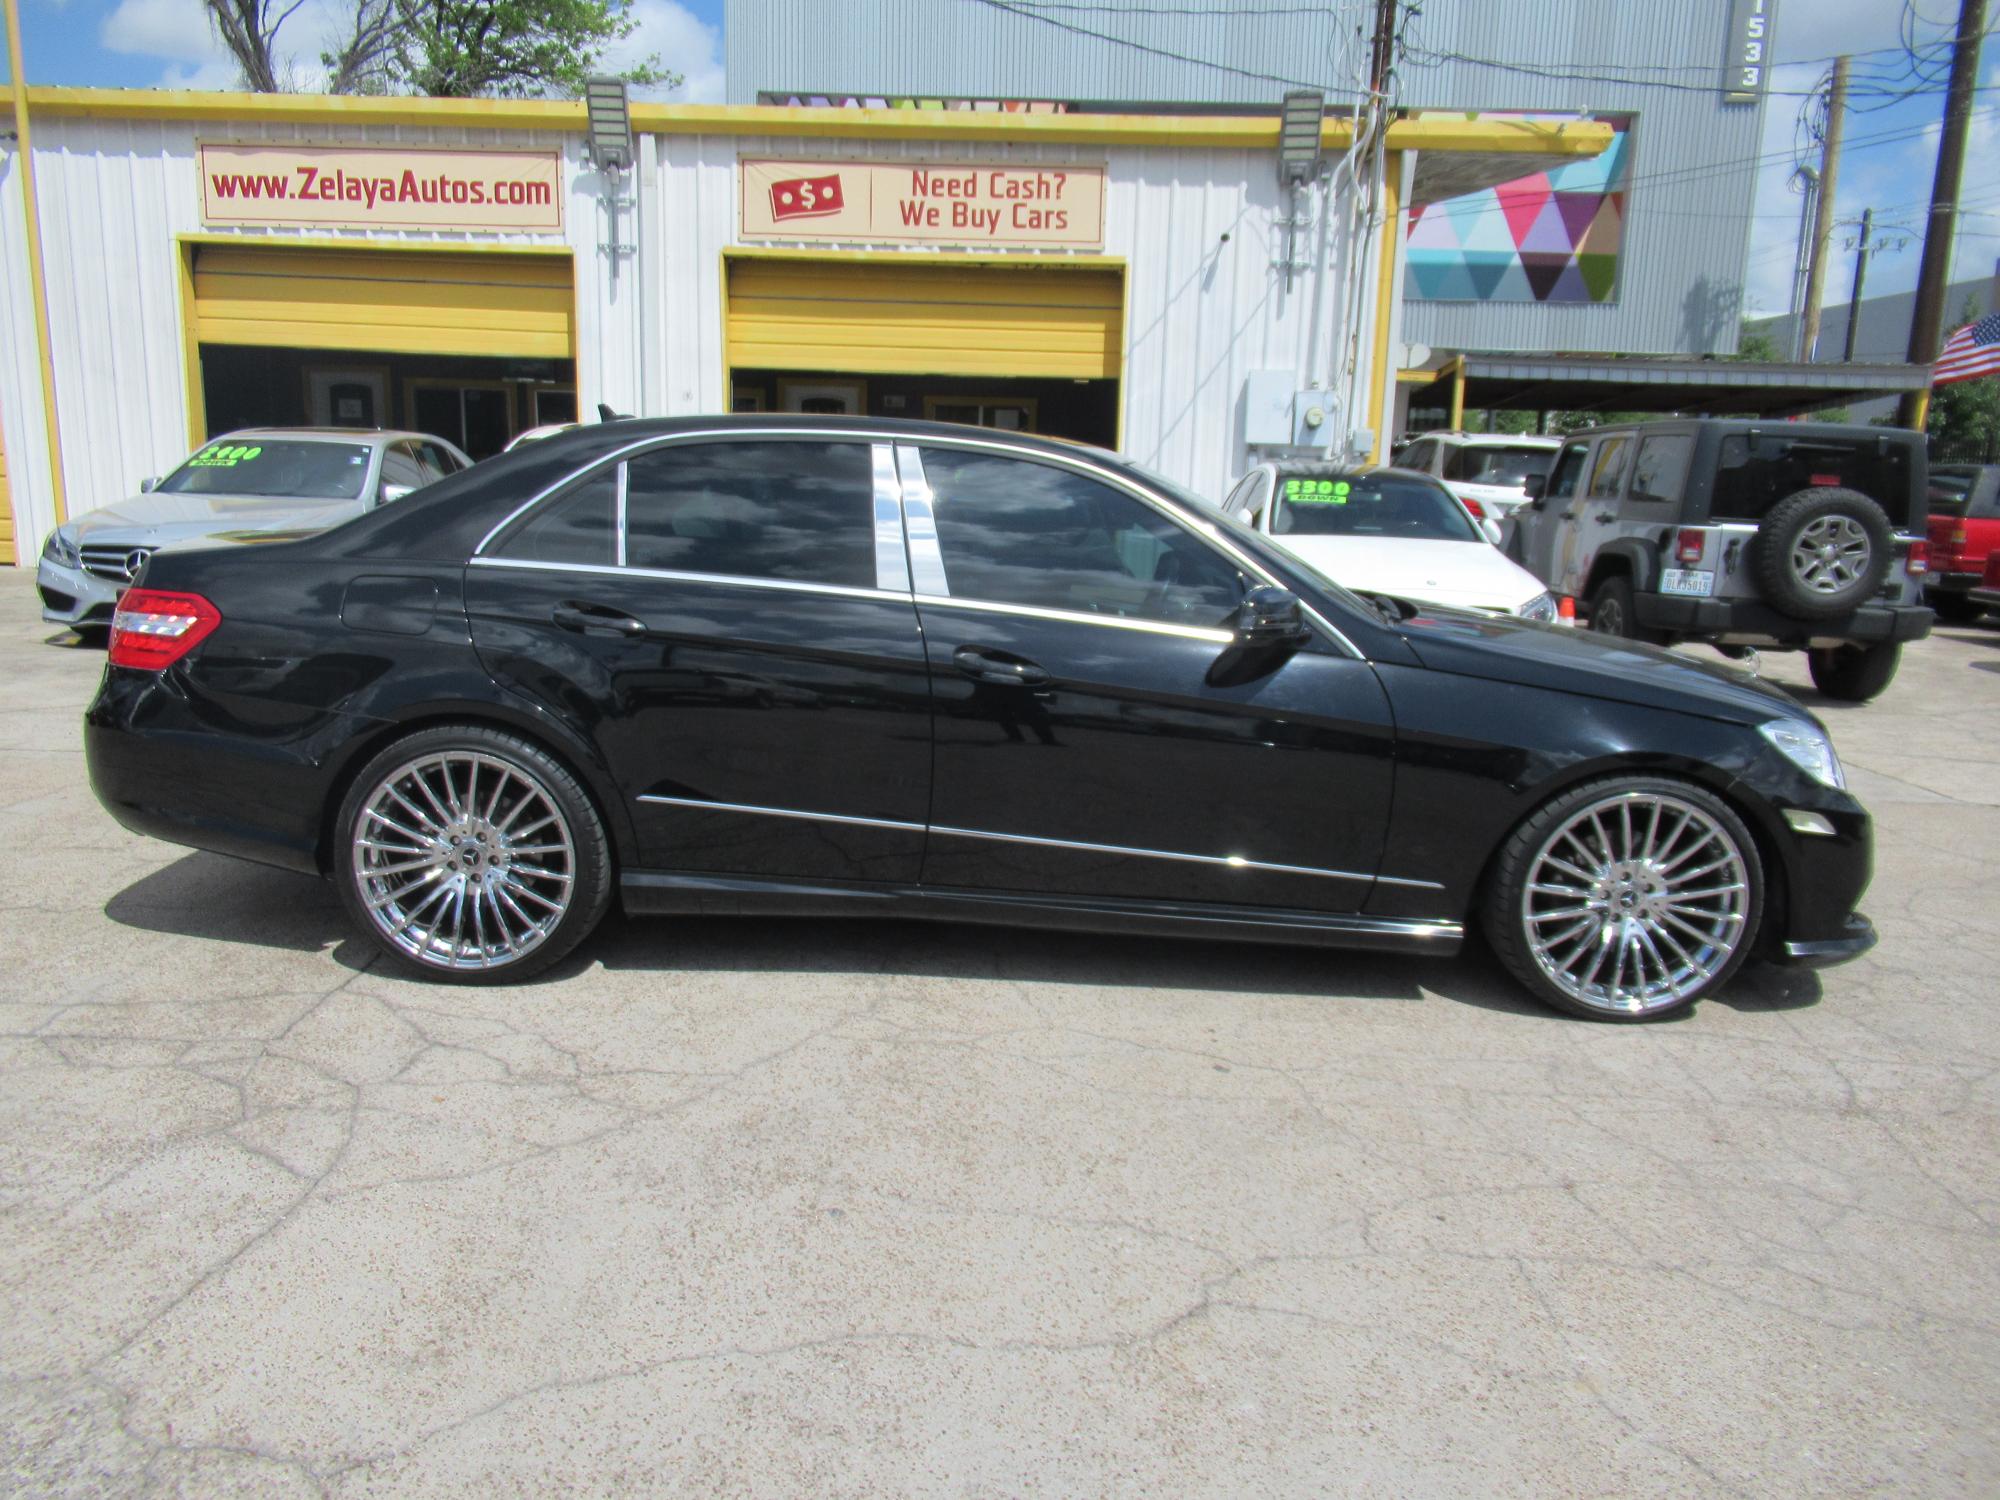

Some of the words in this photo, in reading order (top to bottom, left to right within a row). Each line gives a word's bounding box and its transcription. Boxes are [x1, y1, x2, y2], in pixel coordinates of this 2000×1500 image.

[211, 167, 551, 209] www.ZelayaAutos.com
[911, 170, 977, 198] Need
[989, 172, 1067, 200] Cash?
[899, 200, 940, 227] We
[952, 202, 1001, 234] Buy
[1012, 203, 1068, 229] Cars
